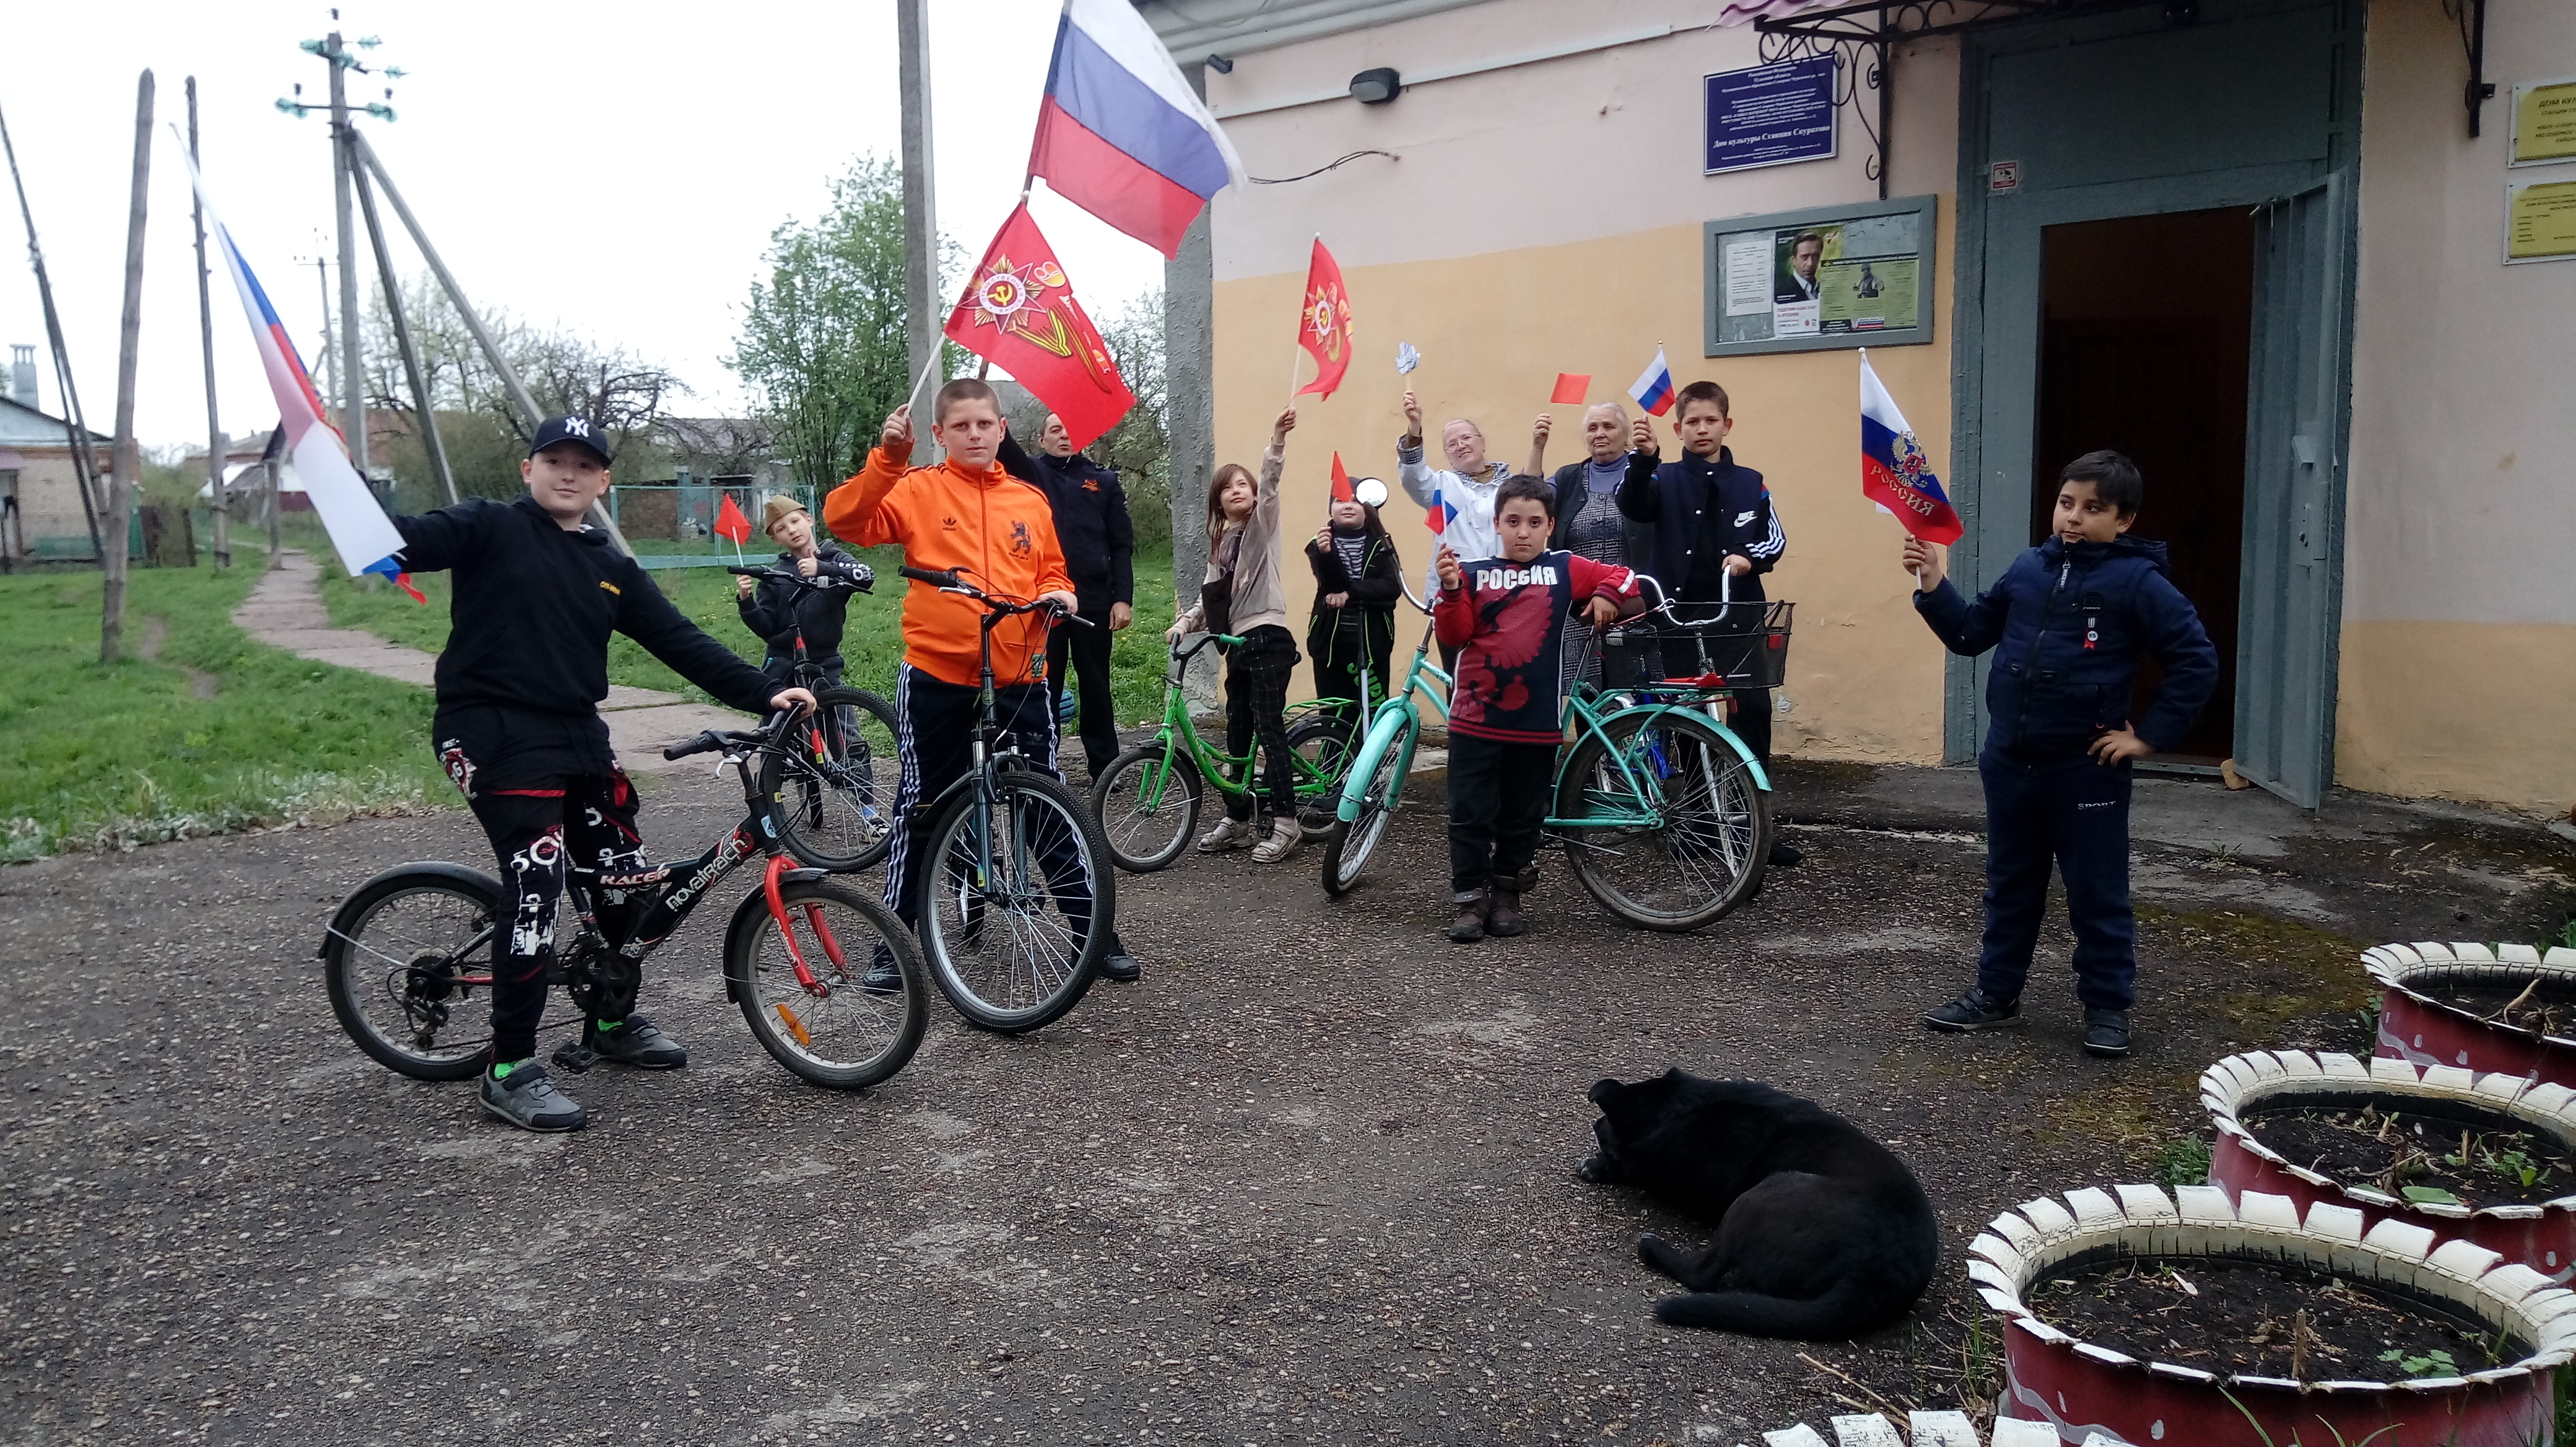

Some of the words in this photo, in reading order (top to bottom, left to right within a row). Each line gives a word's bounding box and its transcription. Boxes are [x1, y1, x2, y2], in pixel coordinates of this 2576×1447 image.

[2539, 99, 2559, 108] ДОМ
[1713, 140, 1728, 149] Дом
[1728, 136, 1761, 146] культуры
[1793, 126, 1830, 136] Скуратово
[1870, 465, 1935, 517] РОССИЯ
[1476, 564, 1558, 592] РОССИЯ
[599, 867, 672, 886] RACER
